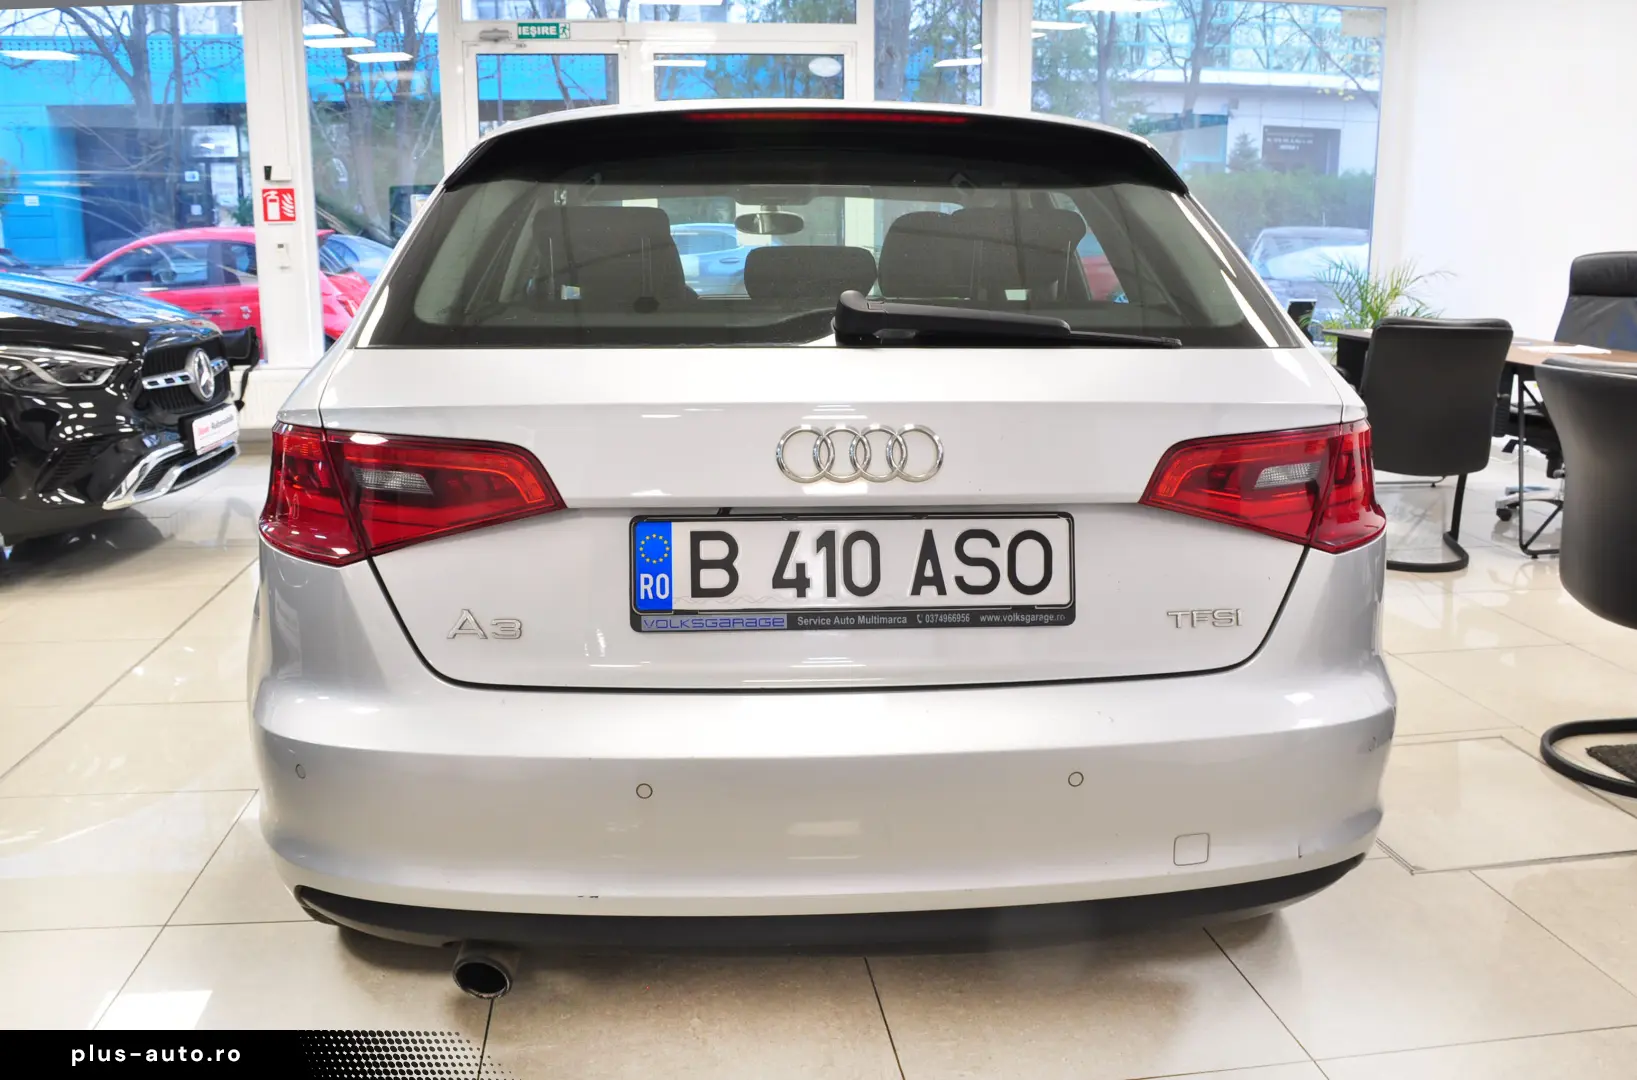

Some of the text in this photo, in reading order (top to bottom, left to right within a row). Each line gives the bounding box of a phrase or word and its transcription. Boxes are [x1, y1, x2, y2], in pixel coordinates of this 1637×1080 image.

[690, 529, 1053, 598] B 410 ASO
[640, 573, 670, 600] RO
[446, 608, 523, 640] A3
[797, 614, 907, 626] Service Auto Multimarca
[925, 613, 970, 624] 0374966956
[980, 612, 1066, 623] www.volksgarage.ro
[1166, 608, 1243, 628] TFSI
